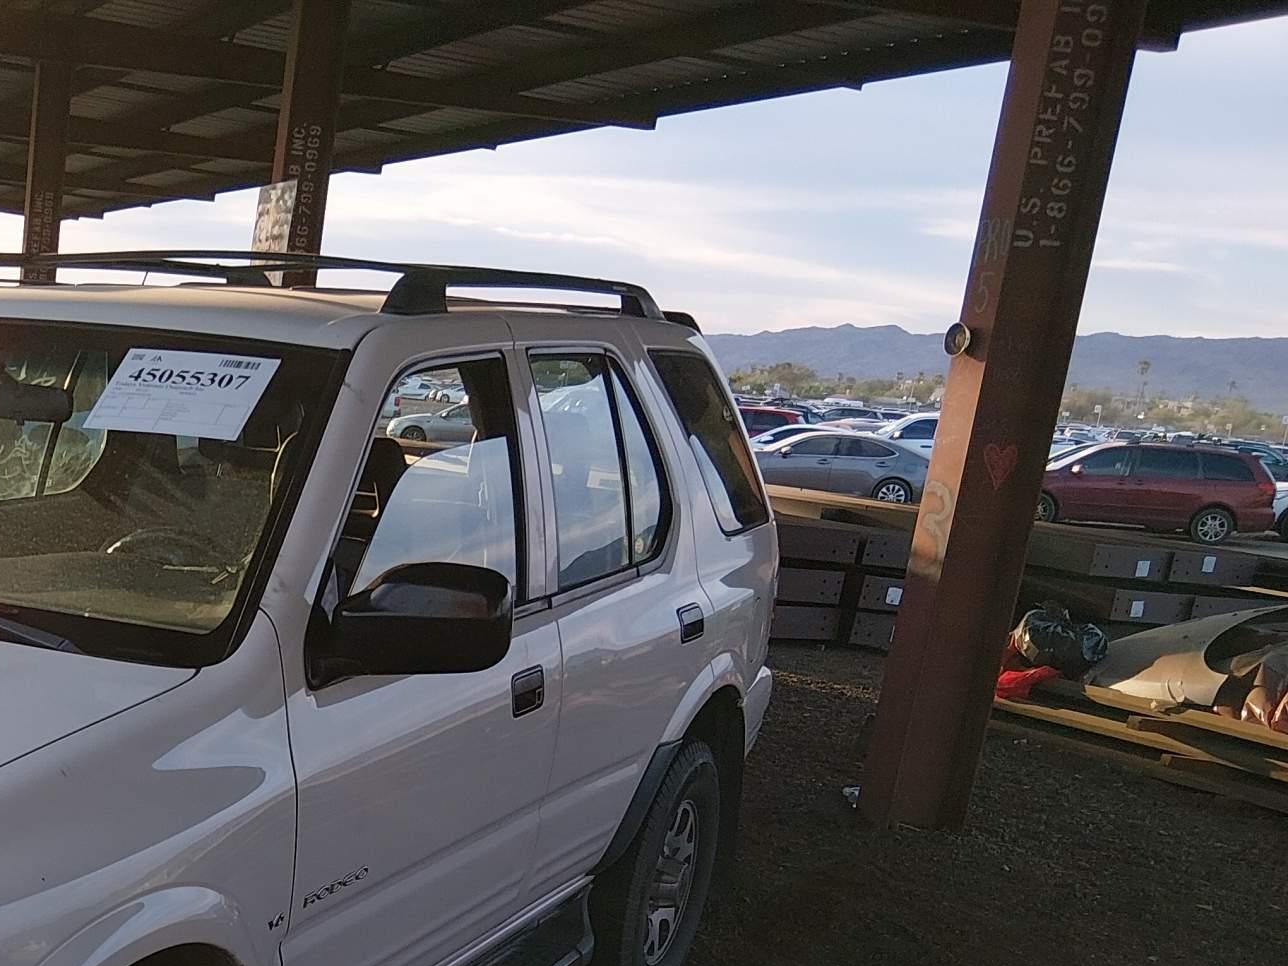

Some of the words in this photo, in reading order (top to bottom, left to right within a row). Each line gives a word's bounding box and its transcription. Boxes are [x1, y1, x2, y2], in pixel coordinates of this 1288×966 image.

[1029, 34, 1074, 166] PREFAB
[291, 122, 308, 156] INC.
[128, 367, 251, 391] 45055307
